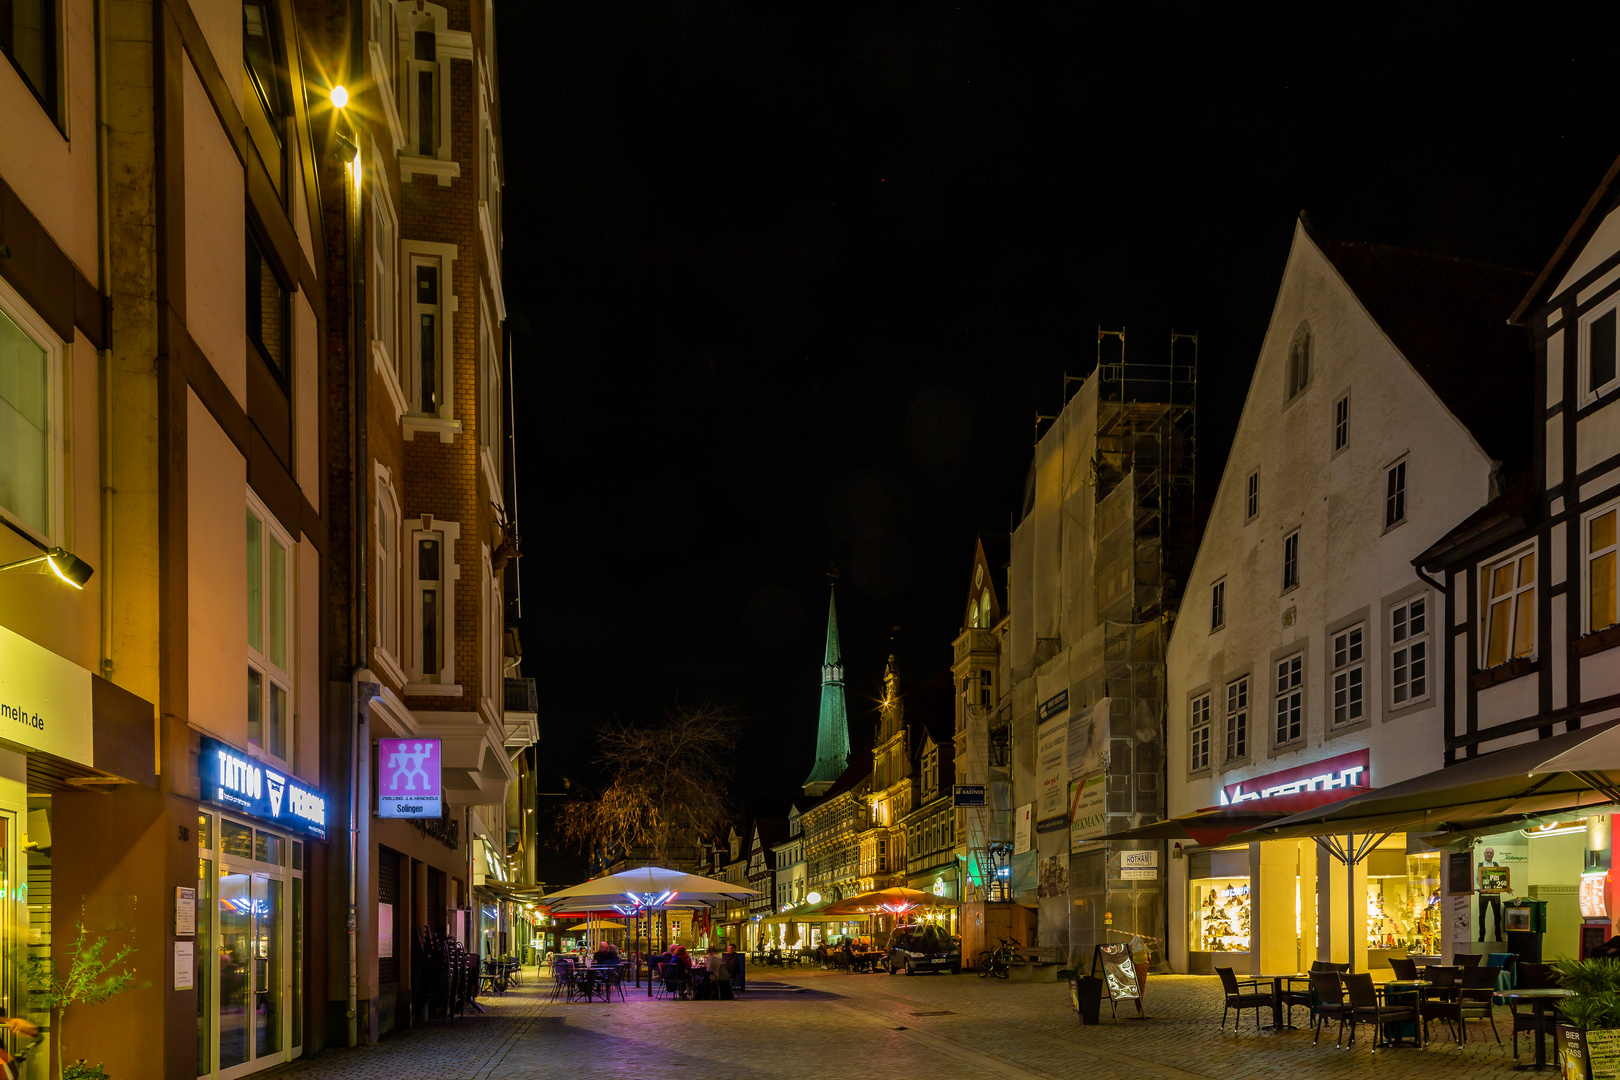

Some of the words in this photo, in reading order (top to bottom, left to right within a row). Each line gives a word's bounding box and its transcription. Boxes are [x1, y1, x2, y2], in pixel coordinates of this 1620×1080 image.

[1, 703, 45, 731] meln.de
[218, 750, 261, 800] TATTOO
[396, 803, 424, 814] Solingen
[1071, 812, 1105, 832] DIEKMANN
[1565, 1031, 1580, 1041] BIER
[1565, 1049, 1582, 1058] FASS
